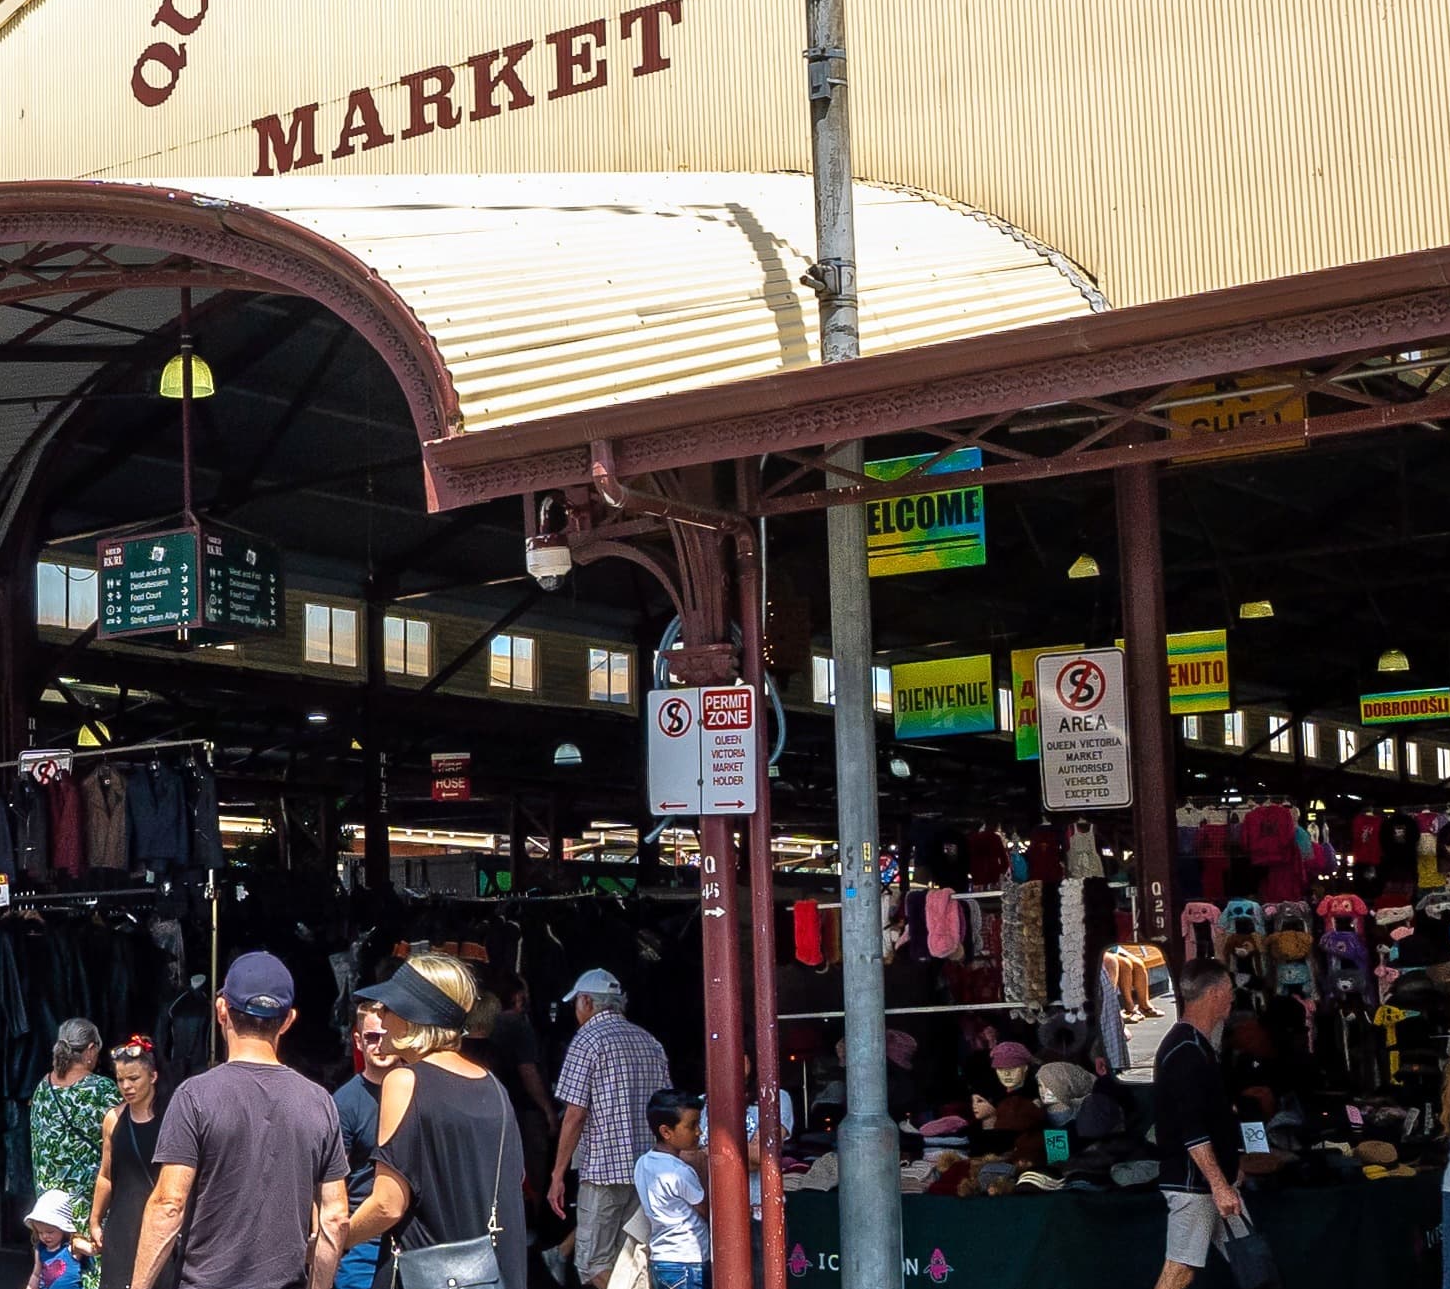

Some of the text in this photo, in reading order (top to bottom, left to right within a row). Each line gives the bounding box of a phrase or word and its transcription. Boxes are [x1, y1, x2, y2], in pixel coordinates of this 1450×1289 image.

[867, 490, 980, 536] ELCOME
[705, 694, 749, 710] PERMIT
[897, 681, 988, 712] BIENVENUE
[1363, 696, 1449, 718] DOBRODOŠLI
[707, 710, 748, 726] ZONE
[1058, 715, 1108, 733] AREA
[715, 735, 742, 745] QUEEN
[1047, 738, 1122, 750] QUEEN VICTORIA
[711, 749, 745, 759] VICTORIA
[1066, 751, 1103, 761] MARKET
[712, 762, 744, 772] MARKET
[1058, 763, 1114, 774] AUTHORISED
[435, 778, 466, 789] HOSE
[712, 776, 744, 786] HOLDER
[1064, 774, 1108, 786] VEHICLES
[1064, 788, 1110, 799] EXCEPTED
